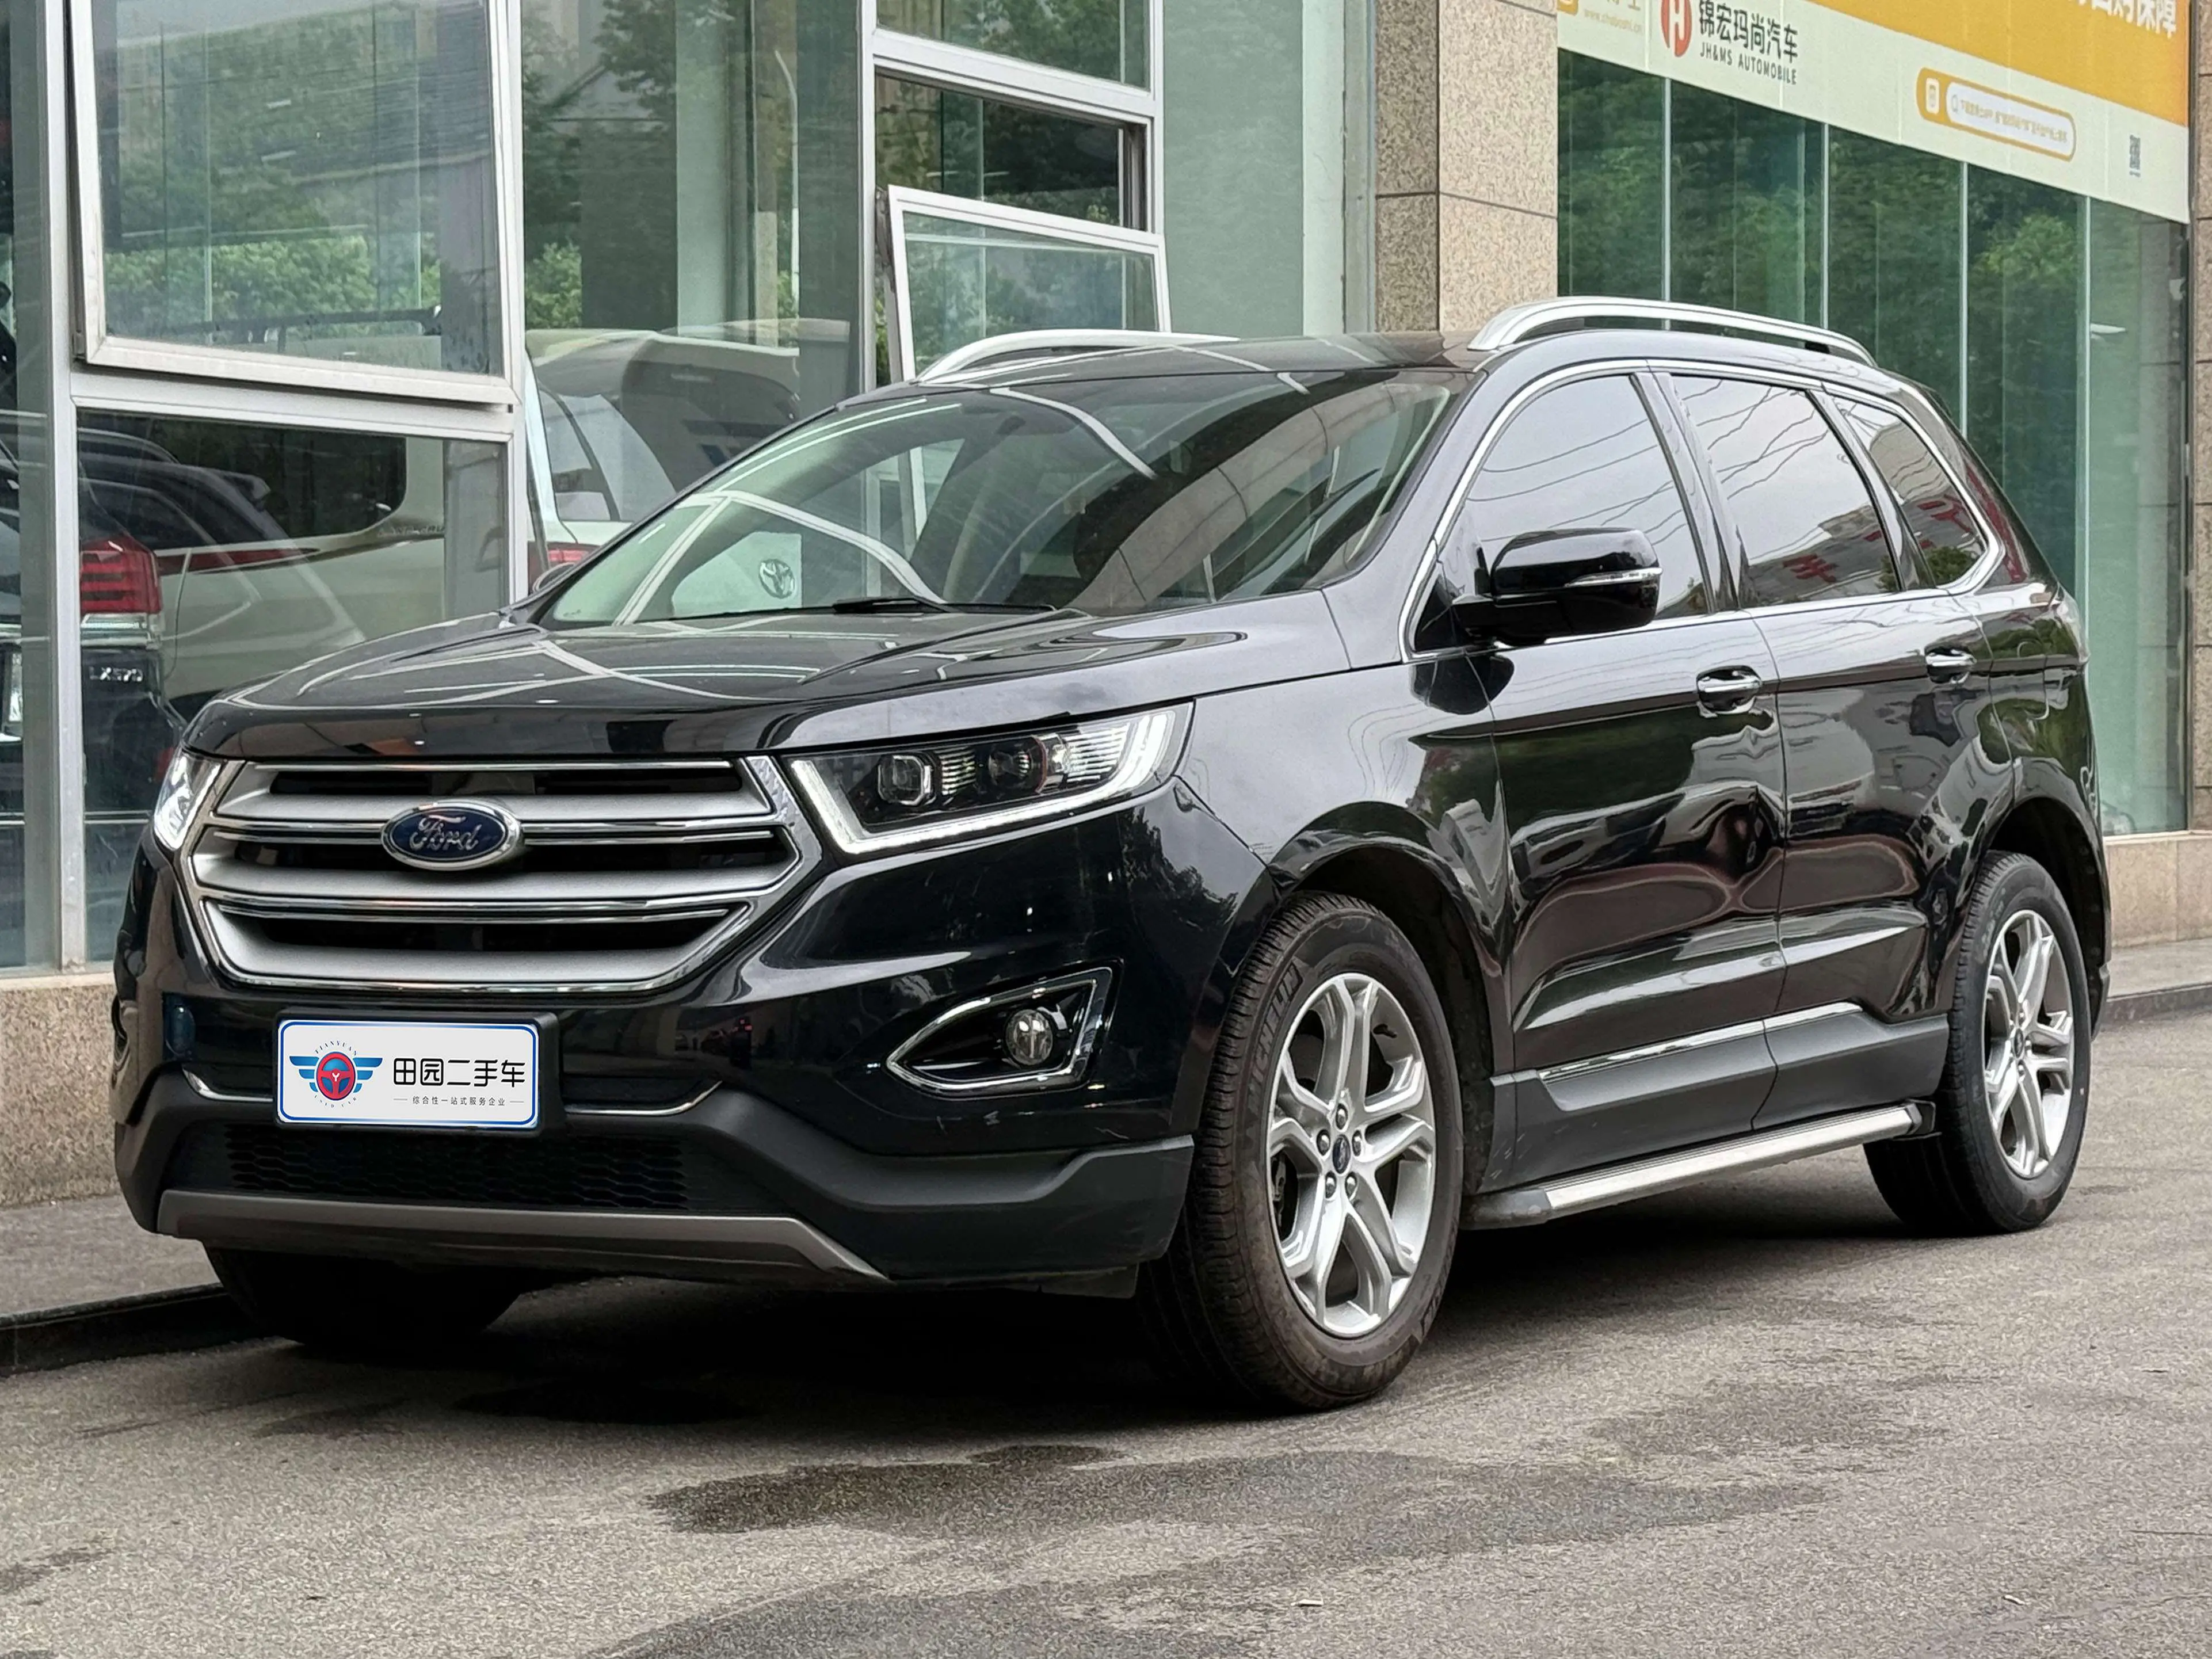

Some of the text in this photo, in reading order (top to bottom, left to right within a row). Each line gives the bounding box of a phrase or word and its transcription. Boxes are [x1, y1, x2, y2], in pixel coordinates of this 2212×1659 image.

[1699, 0, 1798, 63] 锦宏玛尚汽车
[1700, 42, 1797, 85] JH&MS AUTOMOBILE
[409, 814, 482, 851] Ford
